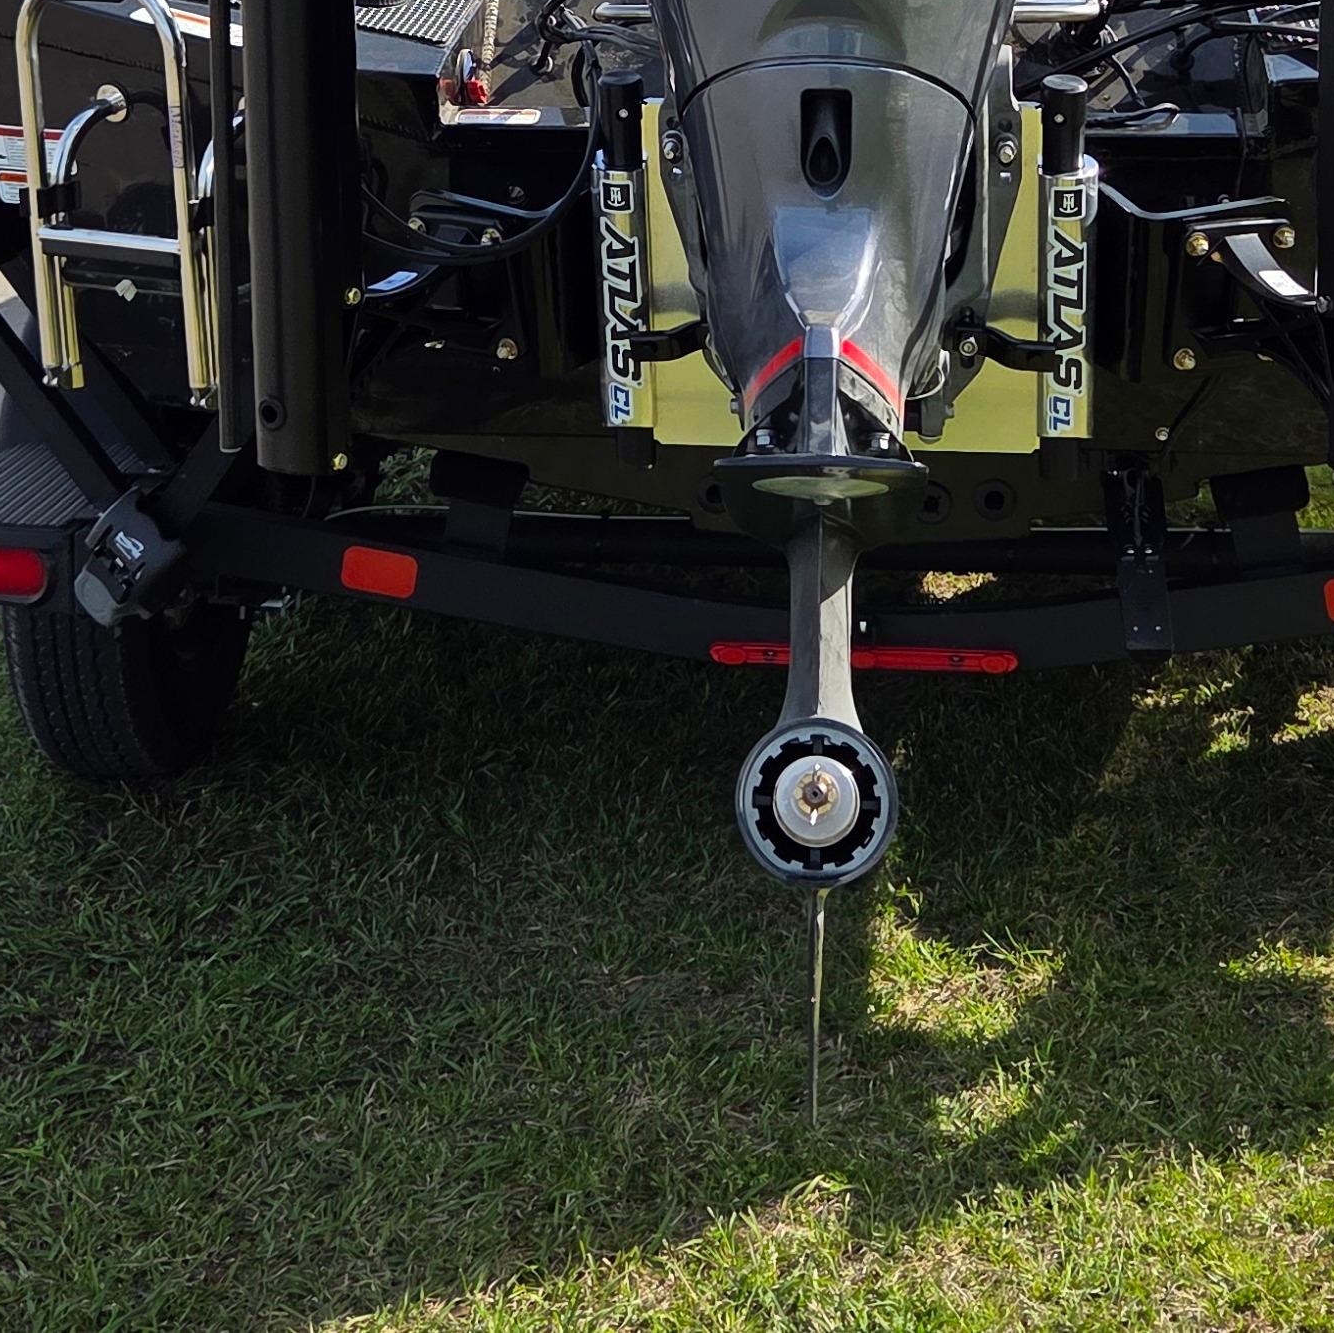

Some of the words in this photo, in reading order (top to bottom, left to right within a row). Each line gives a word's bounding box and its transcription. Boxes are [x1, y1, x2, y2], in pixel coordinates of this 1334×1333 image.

[603, 222, 642, 383] ATLAS
[1052, 231, 1085, 394] ATLAS
[610, 385, 631, 420] CL
[1048, 395, 1071, 432] CL
